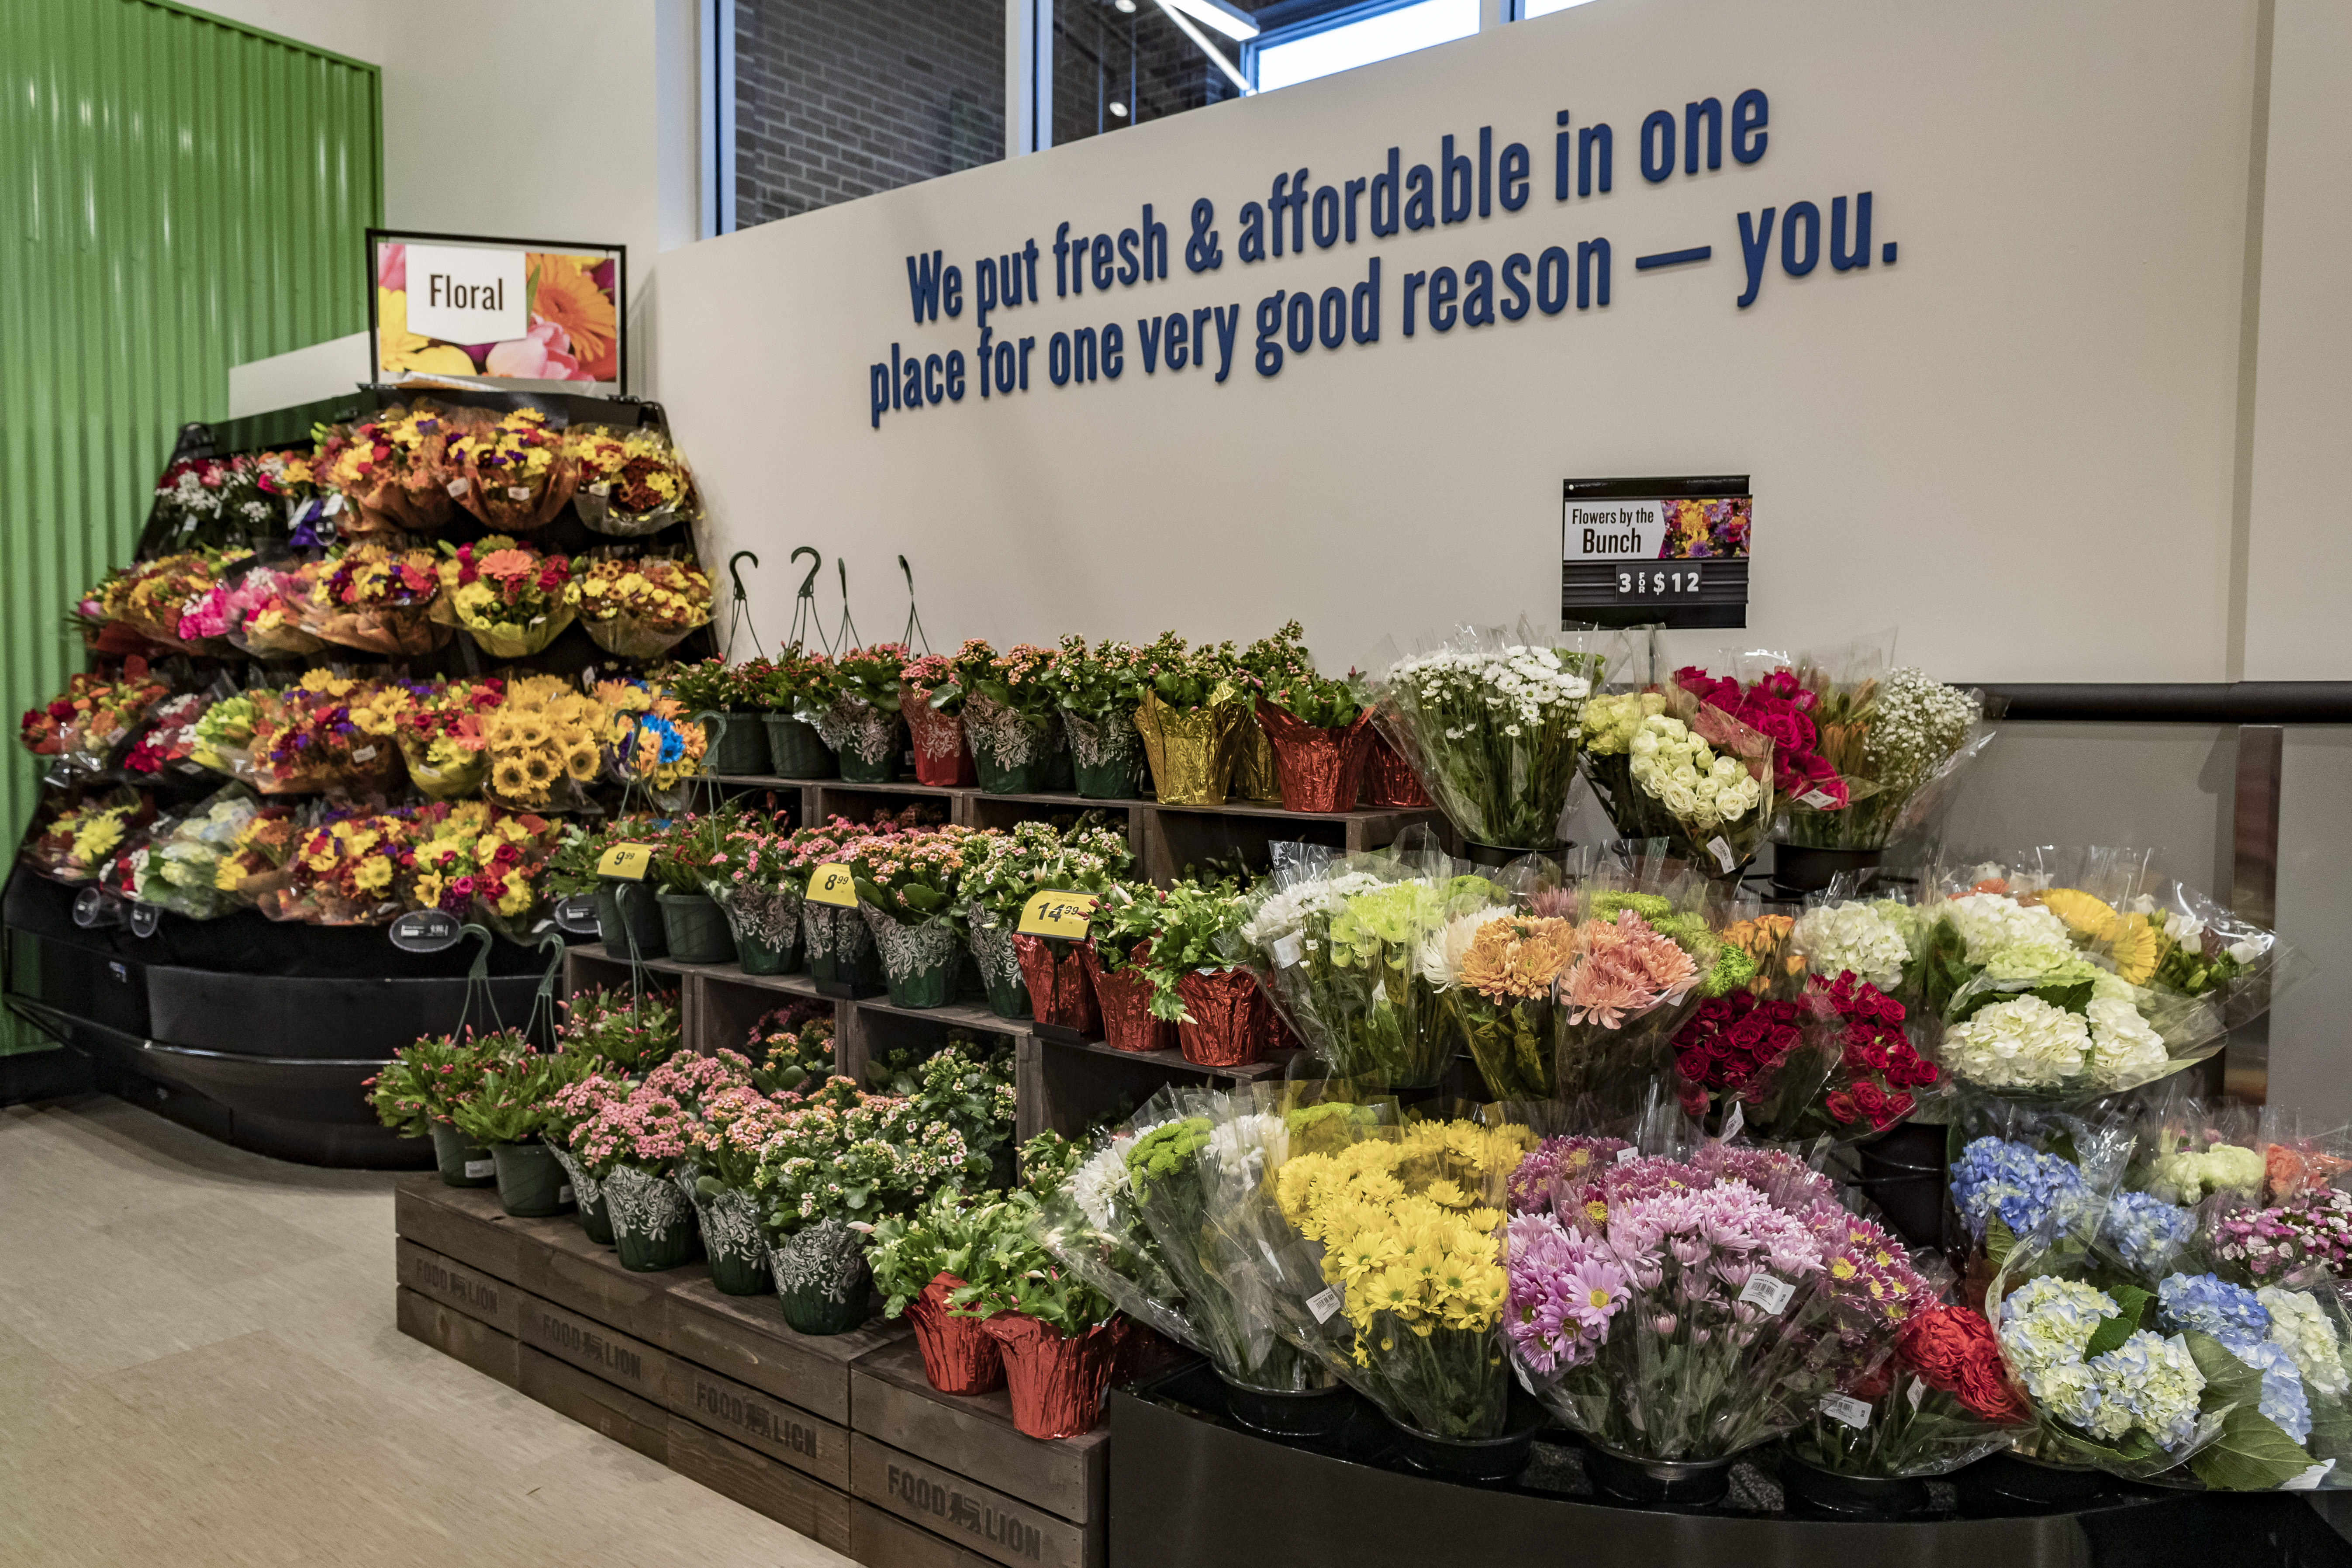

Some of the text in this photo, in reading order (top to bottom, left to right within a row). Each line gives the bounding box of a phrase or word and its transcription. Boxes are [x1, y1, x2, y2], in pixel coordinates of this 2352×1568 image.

[907, 88, 1769, 328] We put fresh & affordable in one
[429, 274, 503, 311] Floral
[871, 343, 964, 428] place
[977, 327, 1035, 397] for
[1049, 323, 1123, 386] one
[1138, 304, 1240, 383] very
[1256, 257, 1380, 376] good
[1403, 238, 1611, 335] reason
[1737, 192, 1897, 307] you.
[1572, 507, 1654, 527] Flowers by the
[1582, 528, 1641, 554] Bunch
[1619, 573, 1631, 593] 3
[1653, 571, 1699, 595] $12
[416, 1257, 498, 1315] FOOD LION
[542, 1314, 642, 1380] FOOD LION
[695, 1381, 743, 1426] FOOD
[887, 1464, 1041, 1561] FOOD LION
